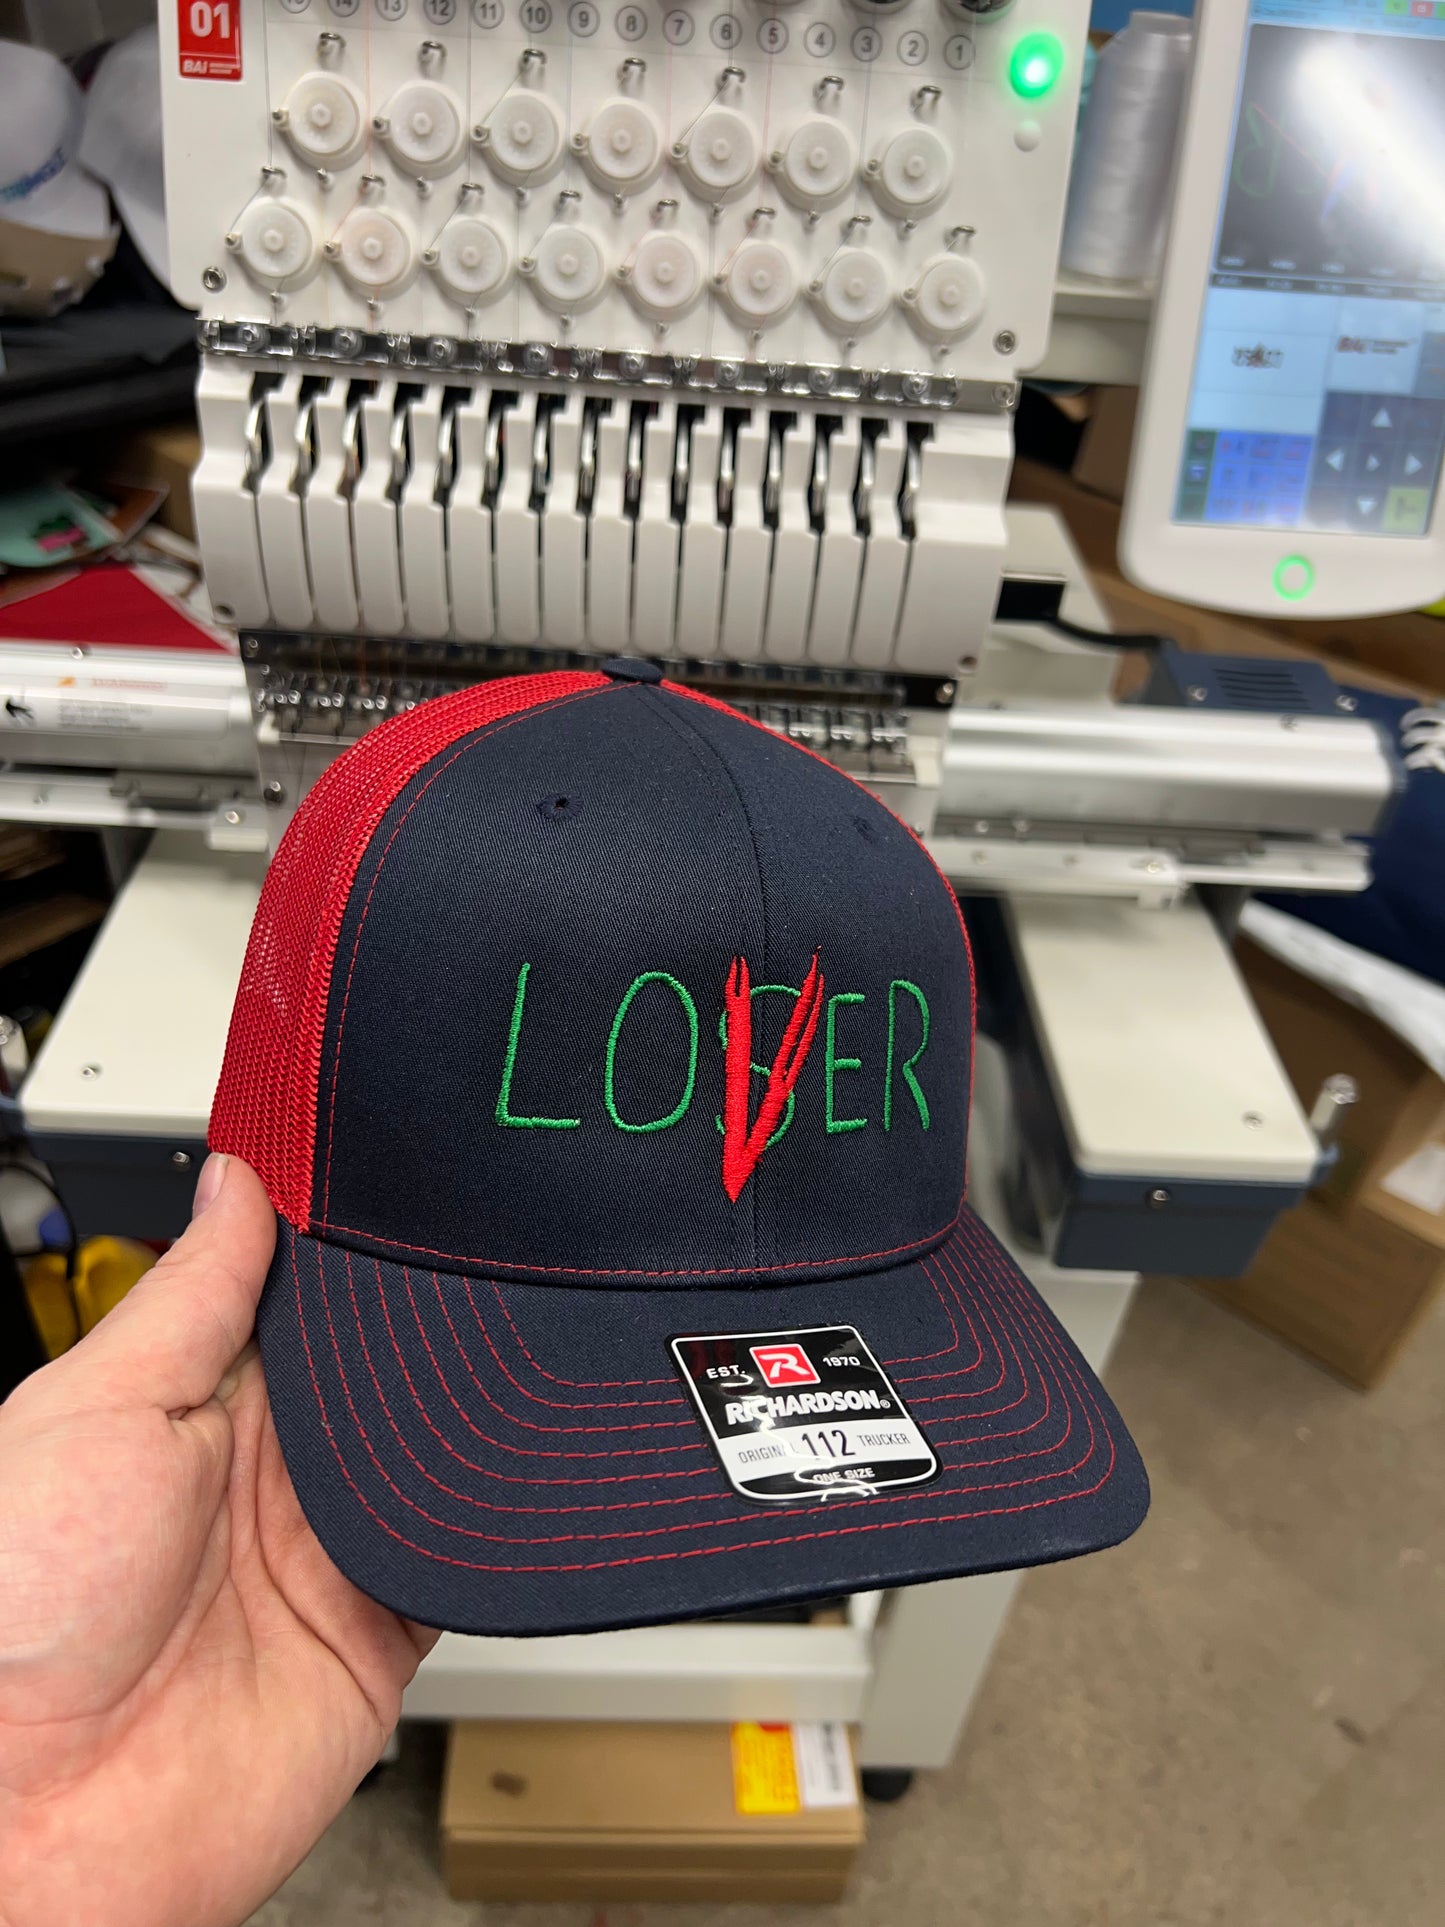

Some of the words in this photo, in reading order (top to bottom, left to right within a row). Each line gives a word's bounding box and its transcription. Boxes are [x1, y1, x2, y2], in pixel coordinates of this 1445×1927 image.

[189, 1, 231, 39] 01
[430, 0, 450, 16] 12
[479, 3, 497, 20] 11
[526, 7, 546, 24] 10
[578, 10, 589, 28] 9
[625, 15, 636, 32] 8
[673, 19, 684, 36] 7
[720, 23, 732, 41] 6
[768, 27, 779, 44] 5
[815, 31, 825, 48] 4
[861, 36, 873, 53] 3
[908, 40, 919, 57] 2
[956, 44, 963, 61] 1
[706, 1364, 745, 1379] EST.
[822, 1355, 860, 1367] 1970
[738, 1443, 799, 1464] ORIGINL
[801, 1429, 856, 1458] 112
[857, 1433, 911, 1447] TRUCKER
[812, 1471, 842, 1483] ONE
[844, 1467, 876, 1479] SIZE
